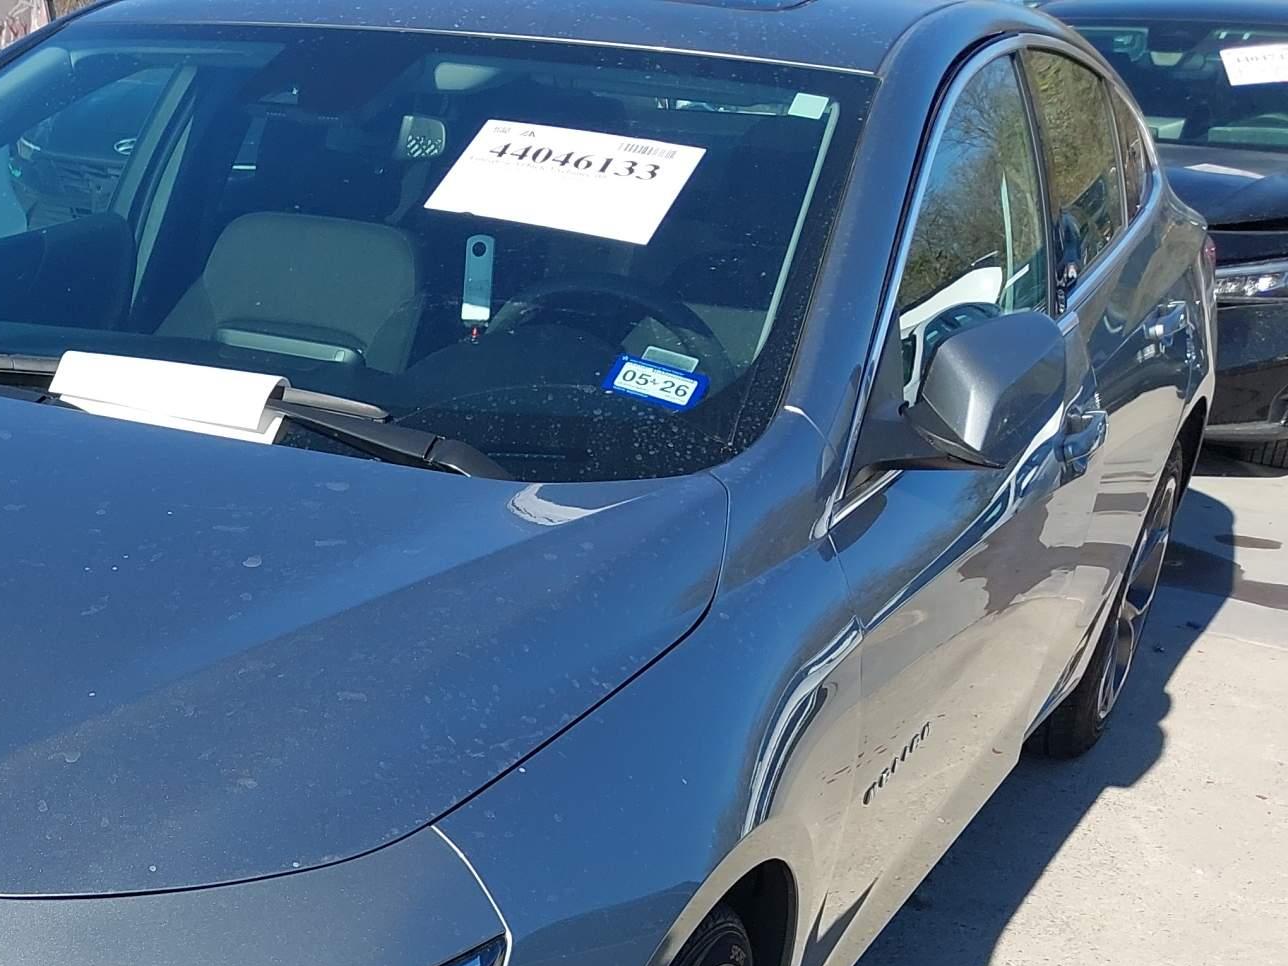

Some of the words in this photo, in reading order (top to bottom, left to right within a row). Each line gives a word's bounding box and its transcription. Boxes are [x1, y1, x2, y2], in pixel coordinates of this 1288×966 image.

[489, 141, 661, 181] 44046133
[622, 369, 652, 386] 05
[659, 380, 690, 398] 26
